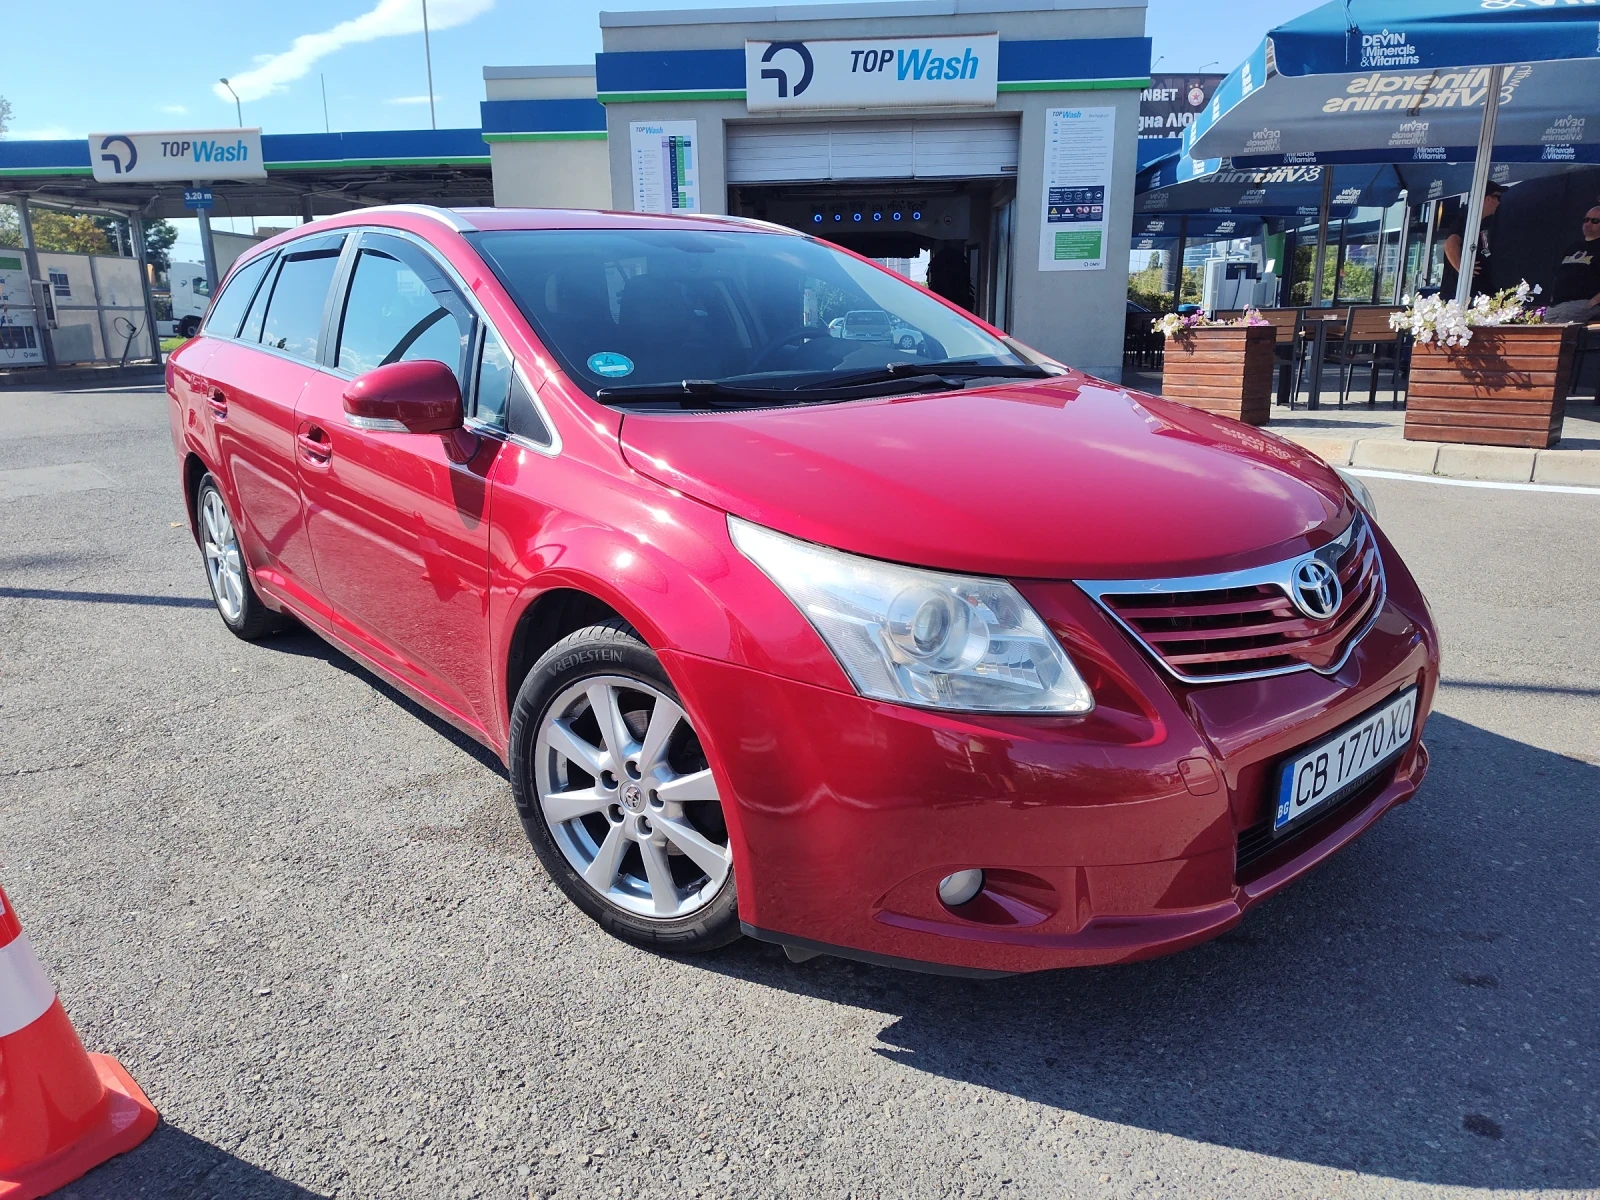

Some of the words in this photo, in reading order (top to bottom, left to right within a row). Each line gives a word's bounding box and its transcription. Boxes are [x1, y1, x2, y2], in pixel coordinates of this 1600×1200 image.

[1362, 32, 1406, 47] DEVIN
[1366, 44, 1416, 57] Minerals
[850, 50, 894, 73] TOP
[897, 48, 979, 81] Wash
[645, 126, 664, 134] Wash
[161, 141, 191, 157] TOP
[192, 139, 248, 162] Wash
[184, 192, 202, 200] 3.20
[547, 649, 623, 676] VREDESTEIN
[1295, 752, 1329, 807] CB
[1337, 717, 1385, 783] 1770
[1386, 699, 1412, 750] XO
[1277, 801, 1290, 819] BG
